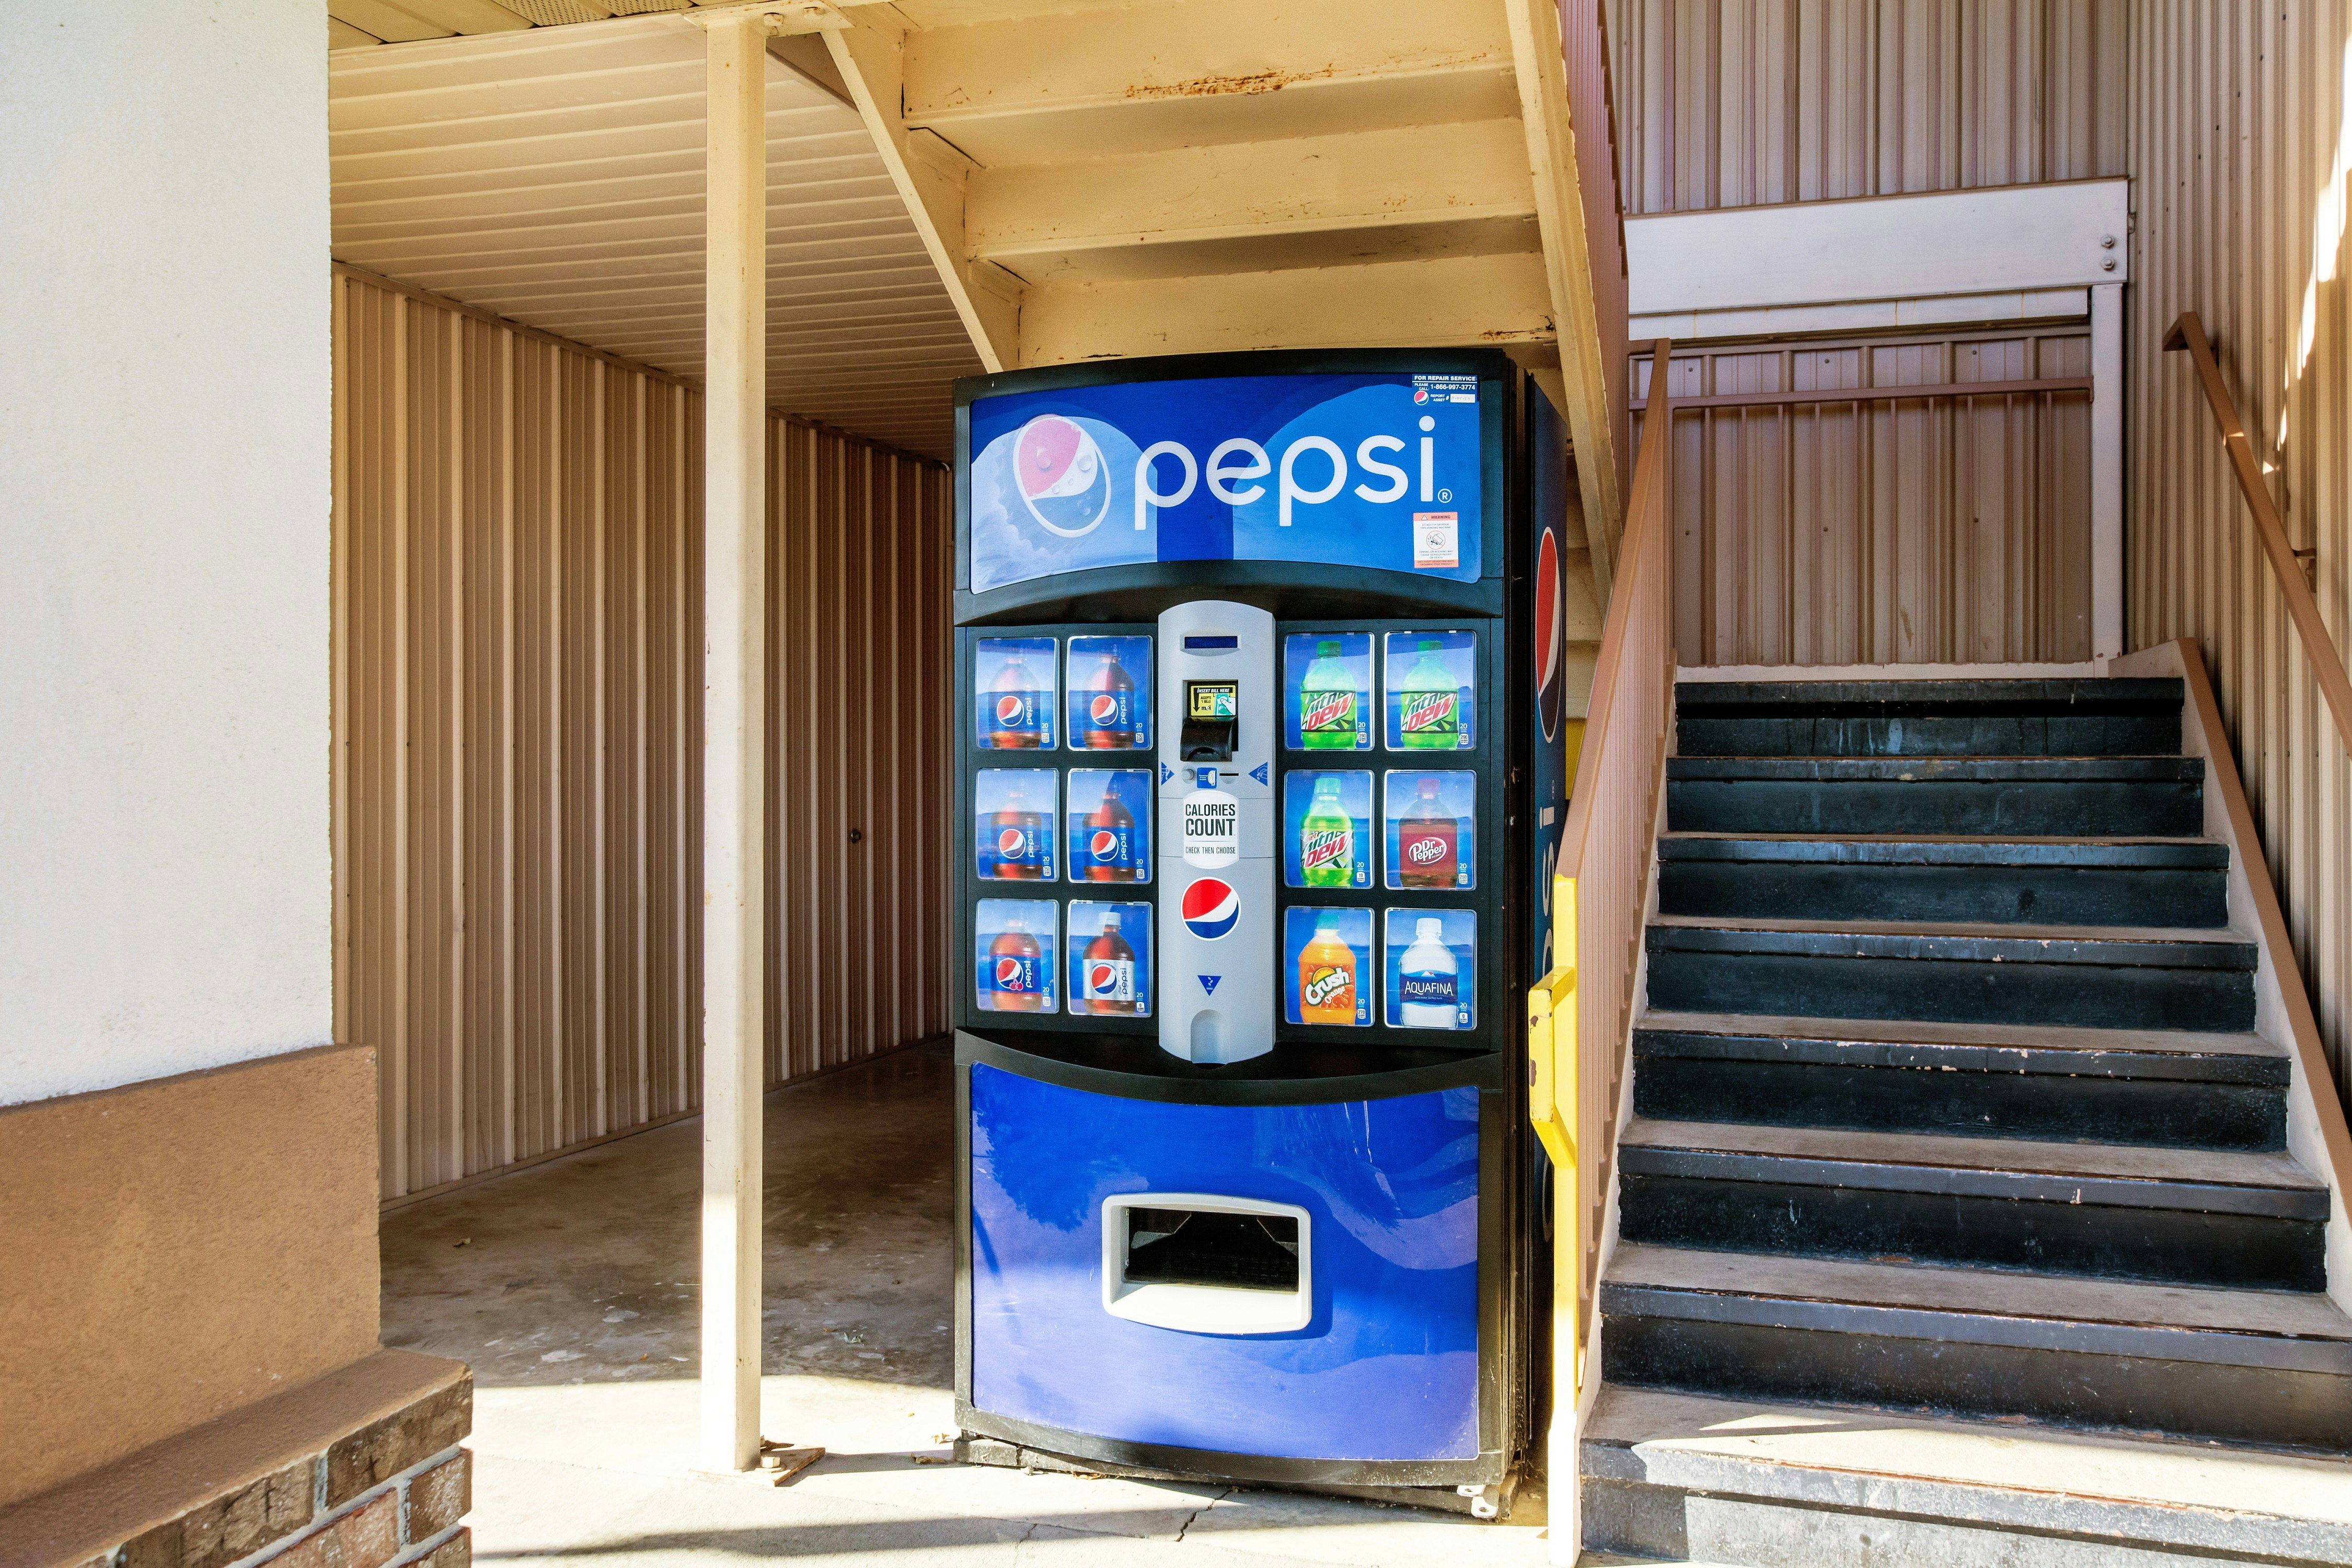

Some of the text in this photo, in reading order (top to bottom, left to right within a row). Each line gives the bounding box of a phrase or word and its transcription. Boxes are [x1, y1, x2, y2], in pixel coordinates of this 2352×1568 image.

[1135, 416, 1435, 530] pepsi
[1025, 698, 1033, 725] pepsi
[1185, 804, 1235, 816] CALORIES
[1186, 818, 1236, 836] COUNT
[1411, 843, 1444, 861] Pepper
[1422, 840, 1436, 851] Dr
[1024, 961, 1033, 988] pepsi
[1306, 967, 1350, 1005] Crush
[1405, 981, 1453, 996] AQUAFINA
